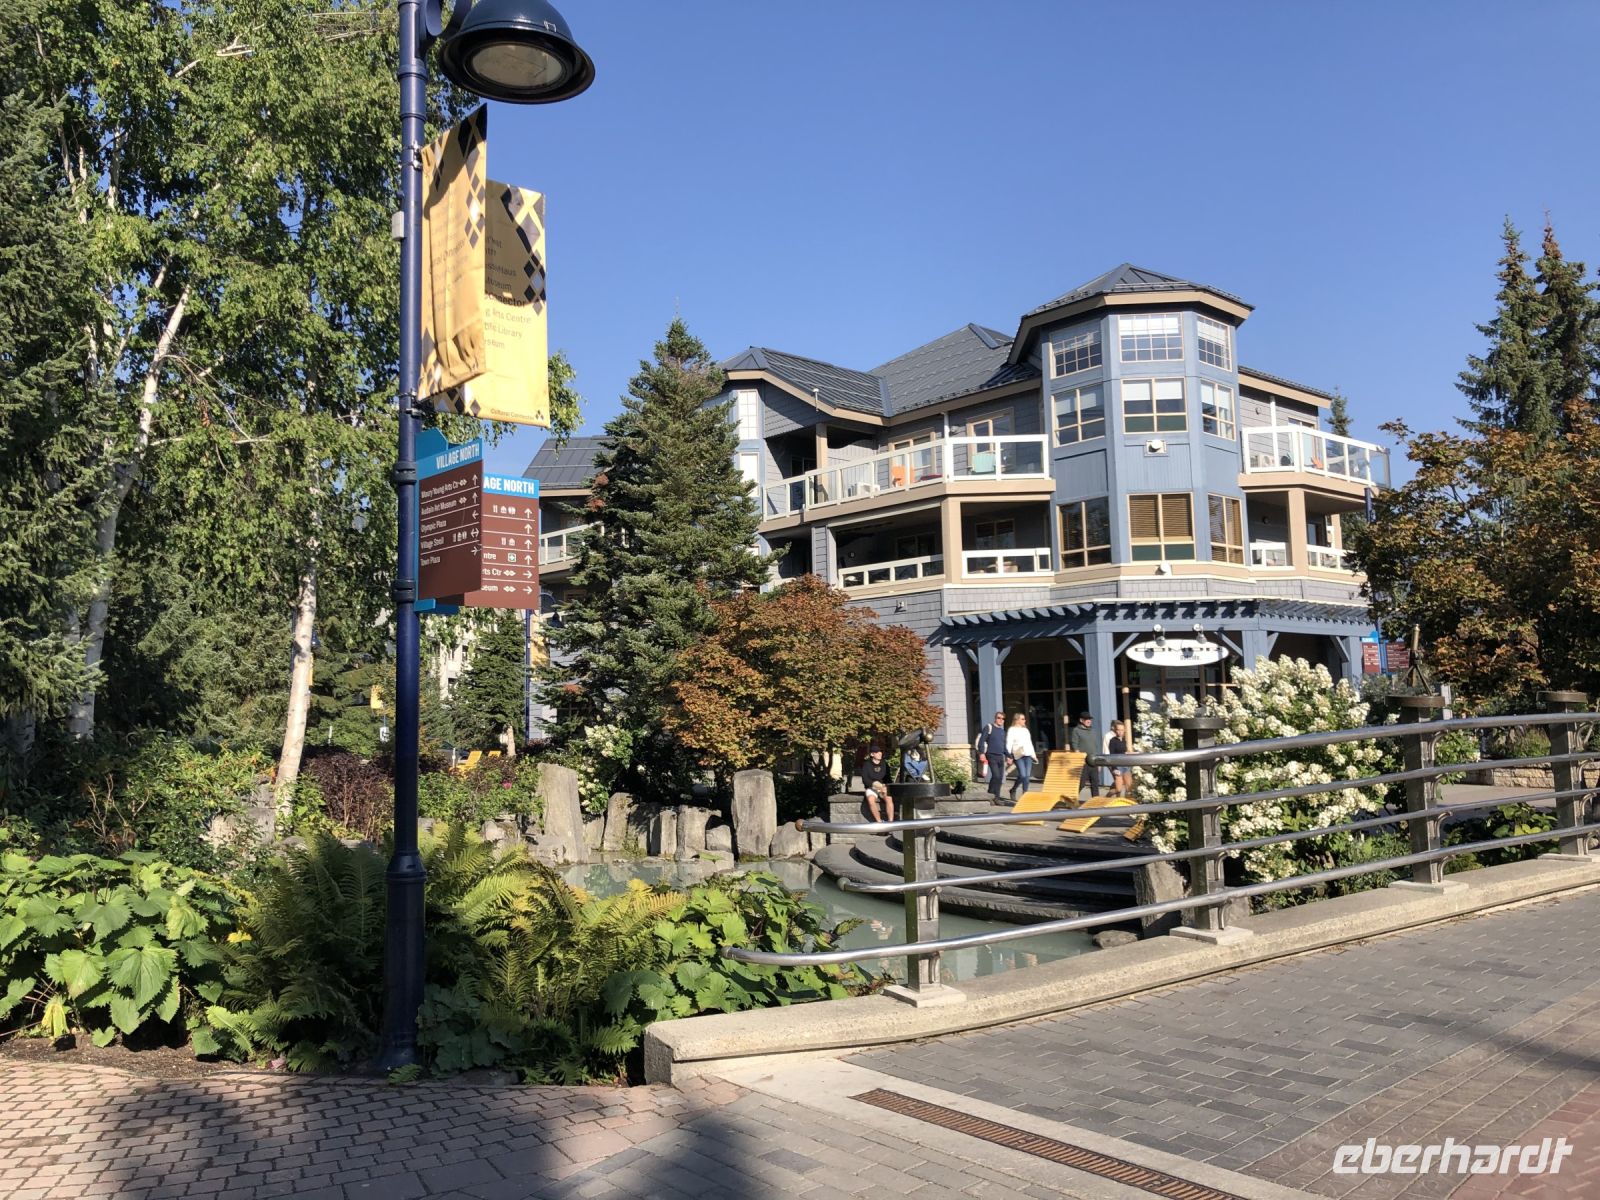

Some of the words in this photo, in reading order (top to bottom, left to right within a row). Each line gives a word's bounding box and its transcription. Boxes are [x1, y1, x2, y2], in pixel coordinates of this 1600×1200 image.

[436, 449, 460, 471] VILLAGE
[460, 442, 480, 463] NORTH
[503, 478, 535, 495] NORTH
